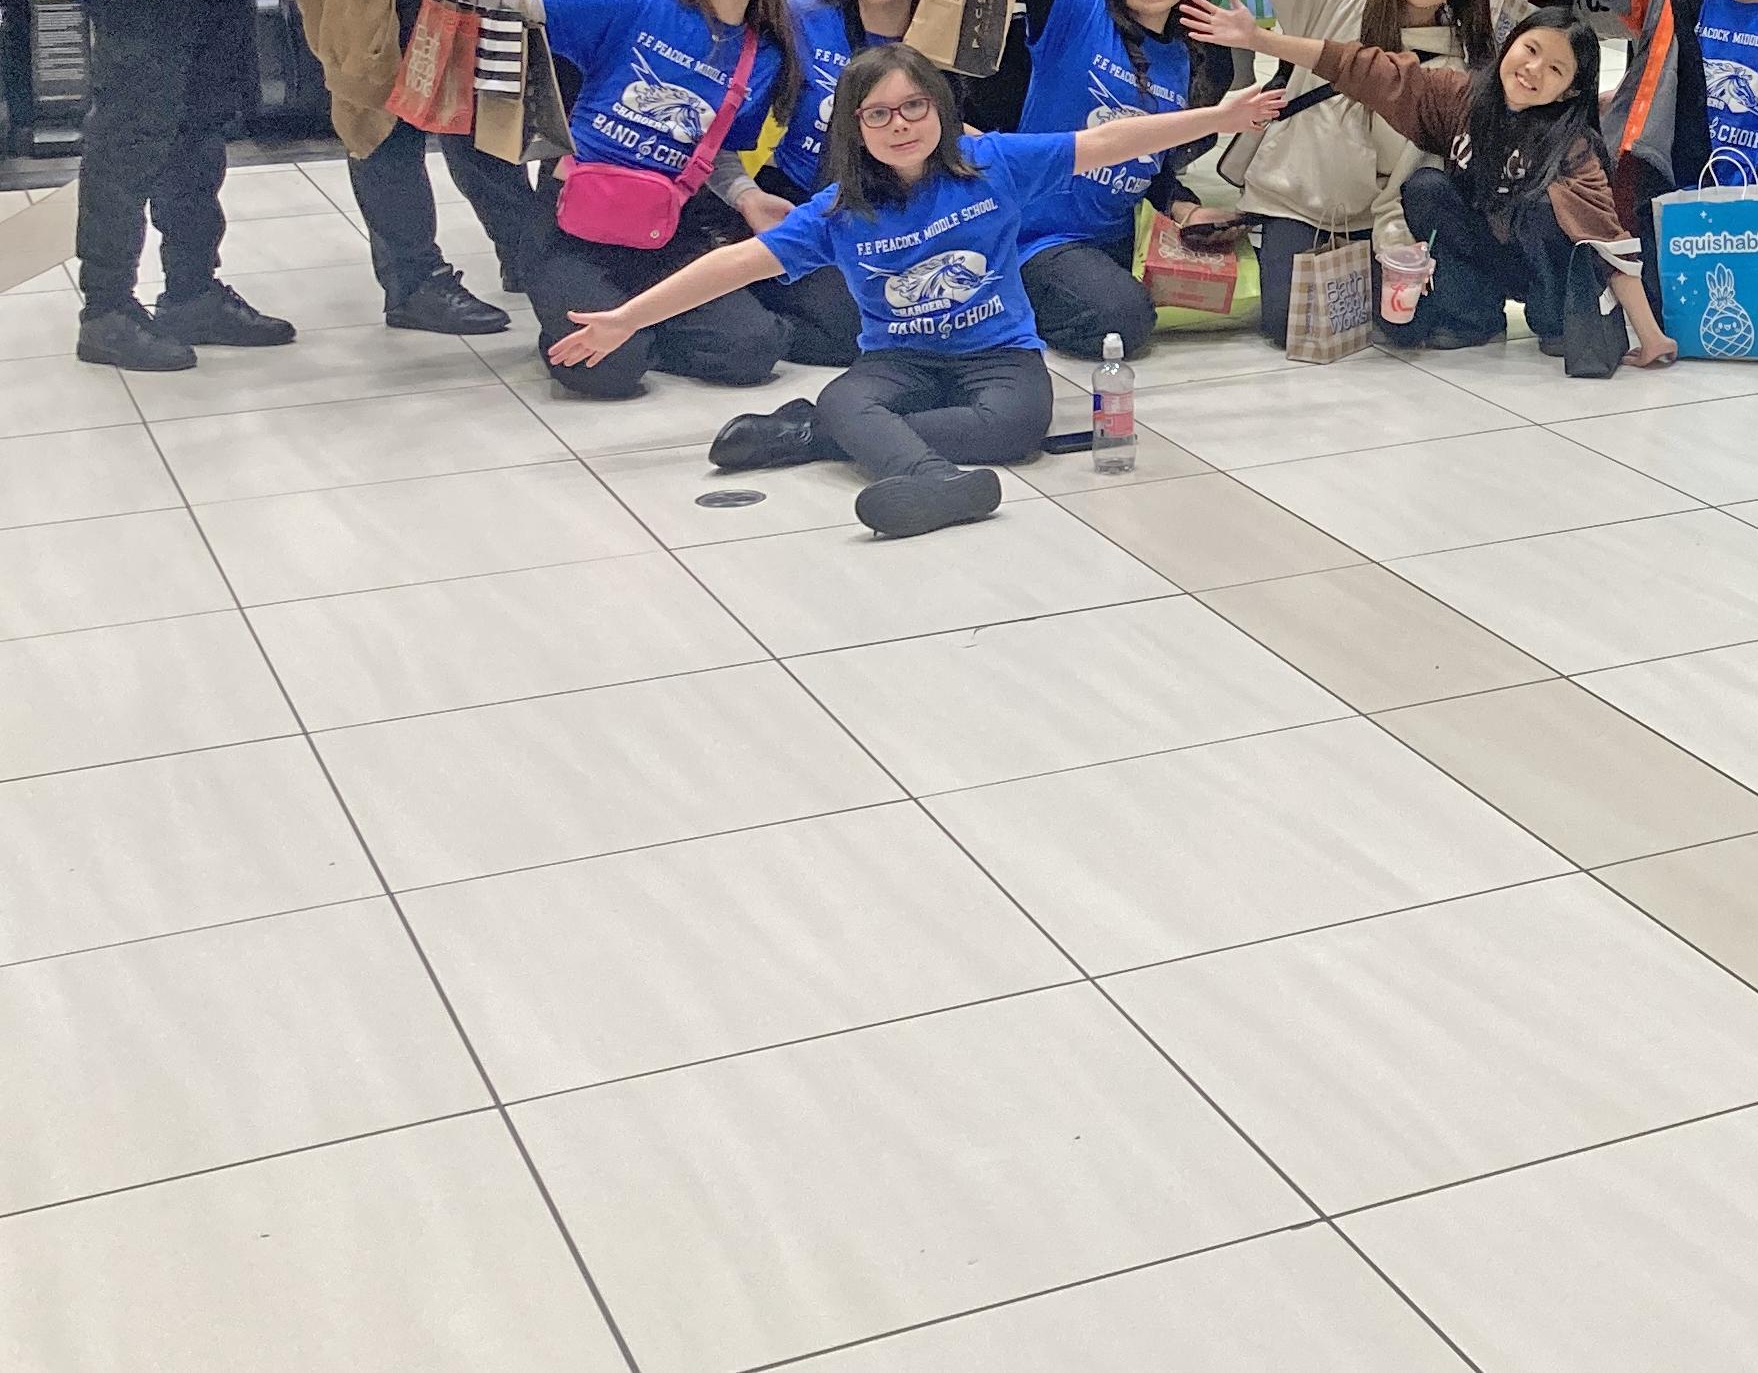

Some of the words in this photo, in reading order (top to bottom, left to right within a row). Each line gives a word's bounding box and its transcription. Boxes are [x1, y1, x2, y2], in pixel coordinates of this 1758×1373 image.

[653, 40, 694, 70] PEACOCK
[591, 113, 640, 149] BAND
[652, 144, 690, 169] CHO
[874, 231, 922, 254] PEACOCK
[923, 212, 961, 241] MIDDLE
[961, 197, 999, 222] SCHOOL
[1327, 271, 1365, 304] Bath
[954, 294, 1005, 330] CHOIR
[1329, 308, 1368, 335] Works
